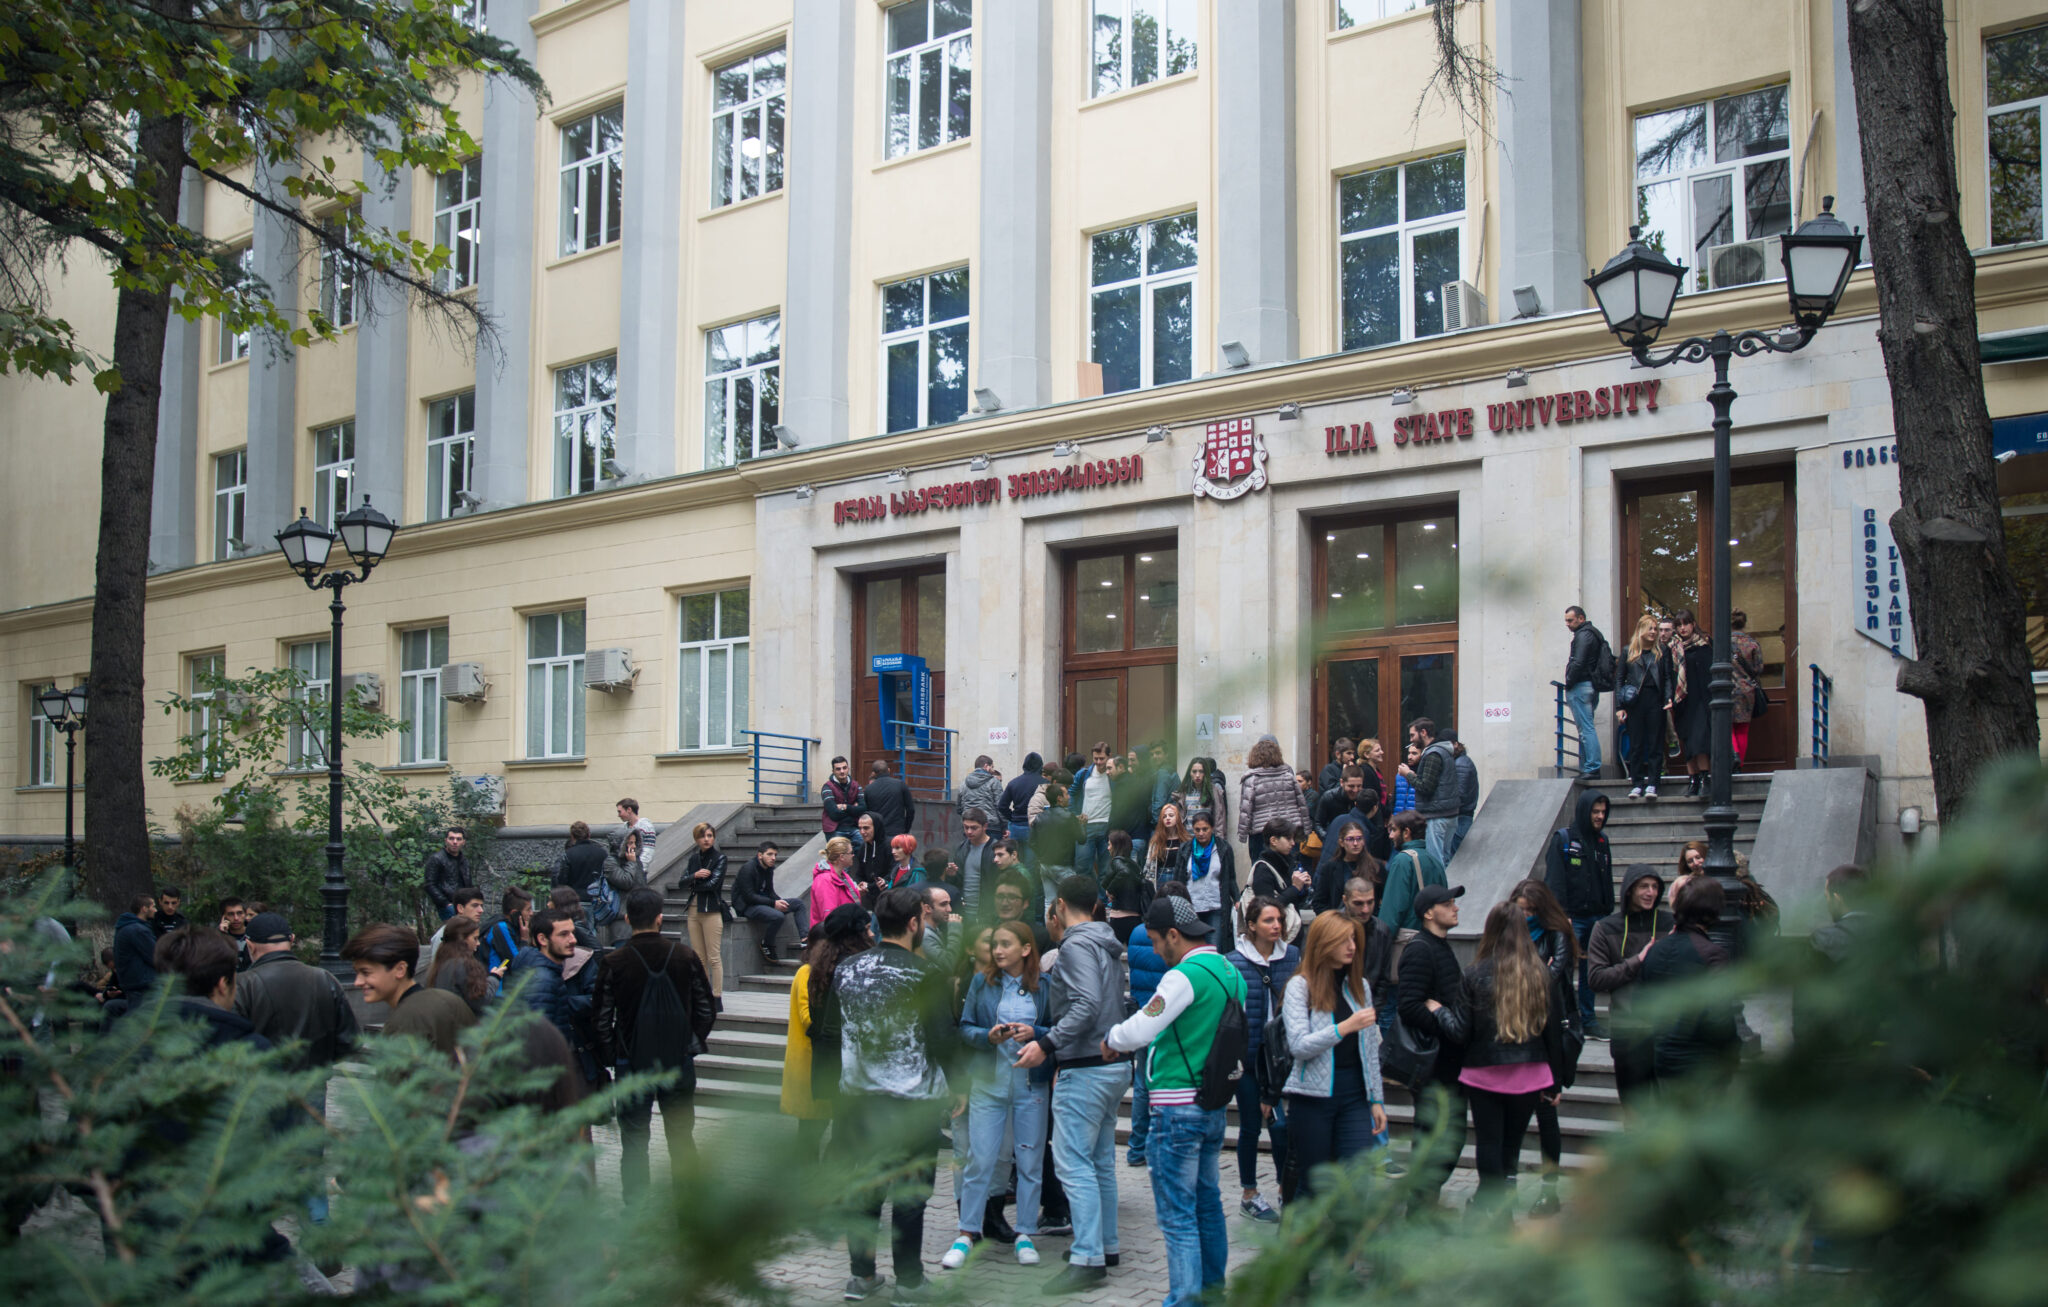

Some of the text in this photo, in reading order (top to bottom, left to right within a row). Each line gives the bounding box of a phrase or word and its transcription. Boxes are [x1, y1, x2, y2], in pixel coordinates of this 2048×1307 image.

[1326, 379, 1661, 455] ILIA STATE UNIVERSITY
[834, 454, 1143, 523] ილიას სახელმწიფო უნივერსიტეტი
[1203, 475, 1256, 497] LIGAMUS
[1843, 444, 1898, 469] წიგნე
[1888, 546, 1902, 658] LIGAMUS
